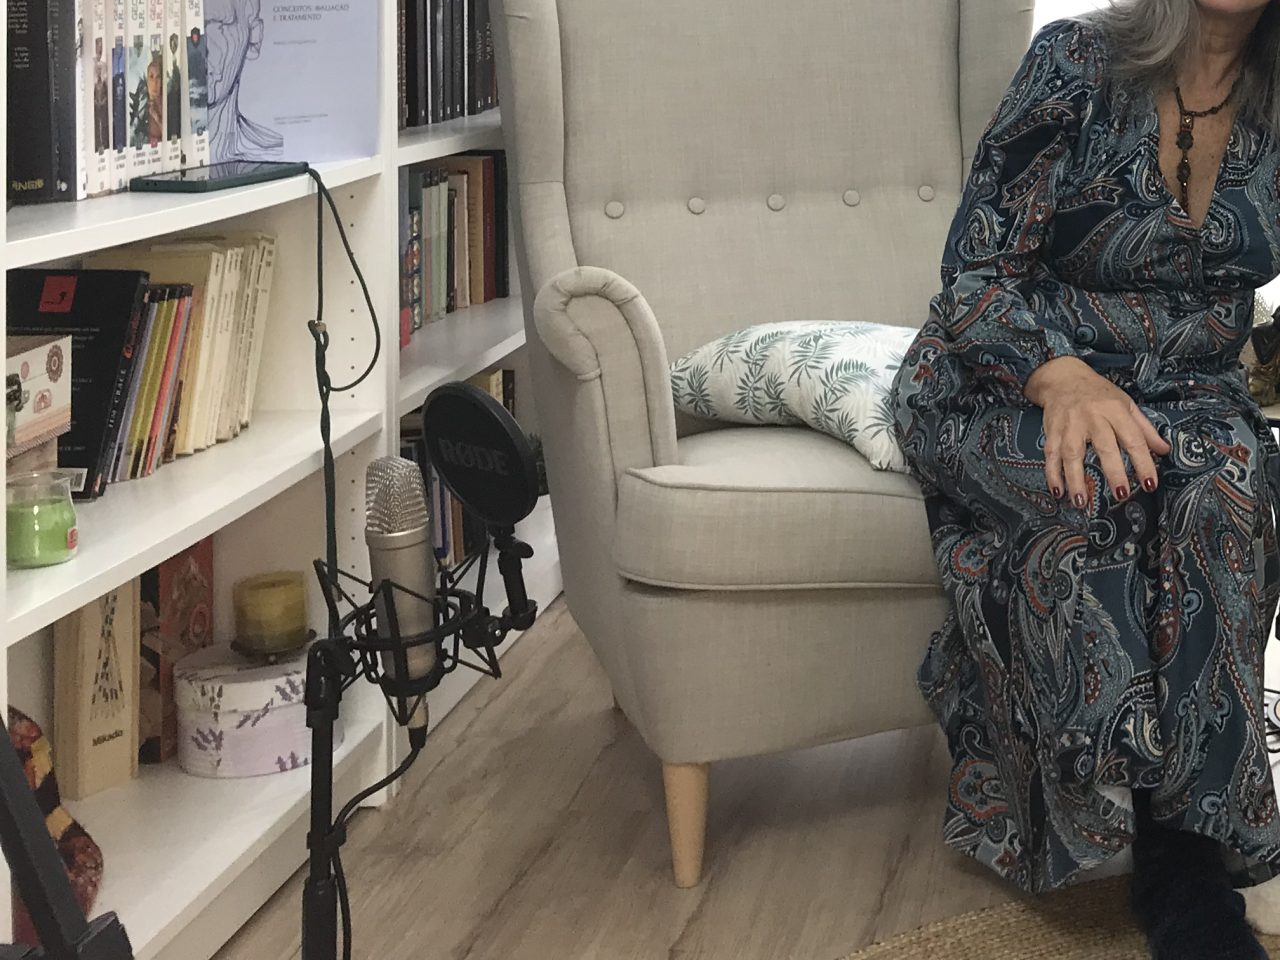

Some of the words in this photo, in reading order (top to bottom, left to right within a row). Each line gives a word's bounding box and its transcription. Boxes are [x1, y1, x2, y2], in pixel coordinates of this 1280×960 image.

[280, 14, 322, 22] TRATAMENTO
[114, 368, 127, 404] CRACE
[438, 437, 509, 476] RØDE
[92, 730, 123, 747] Mikado
